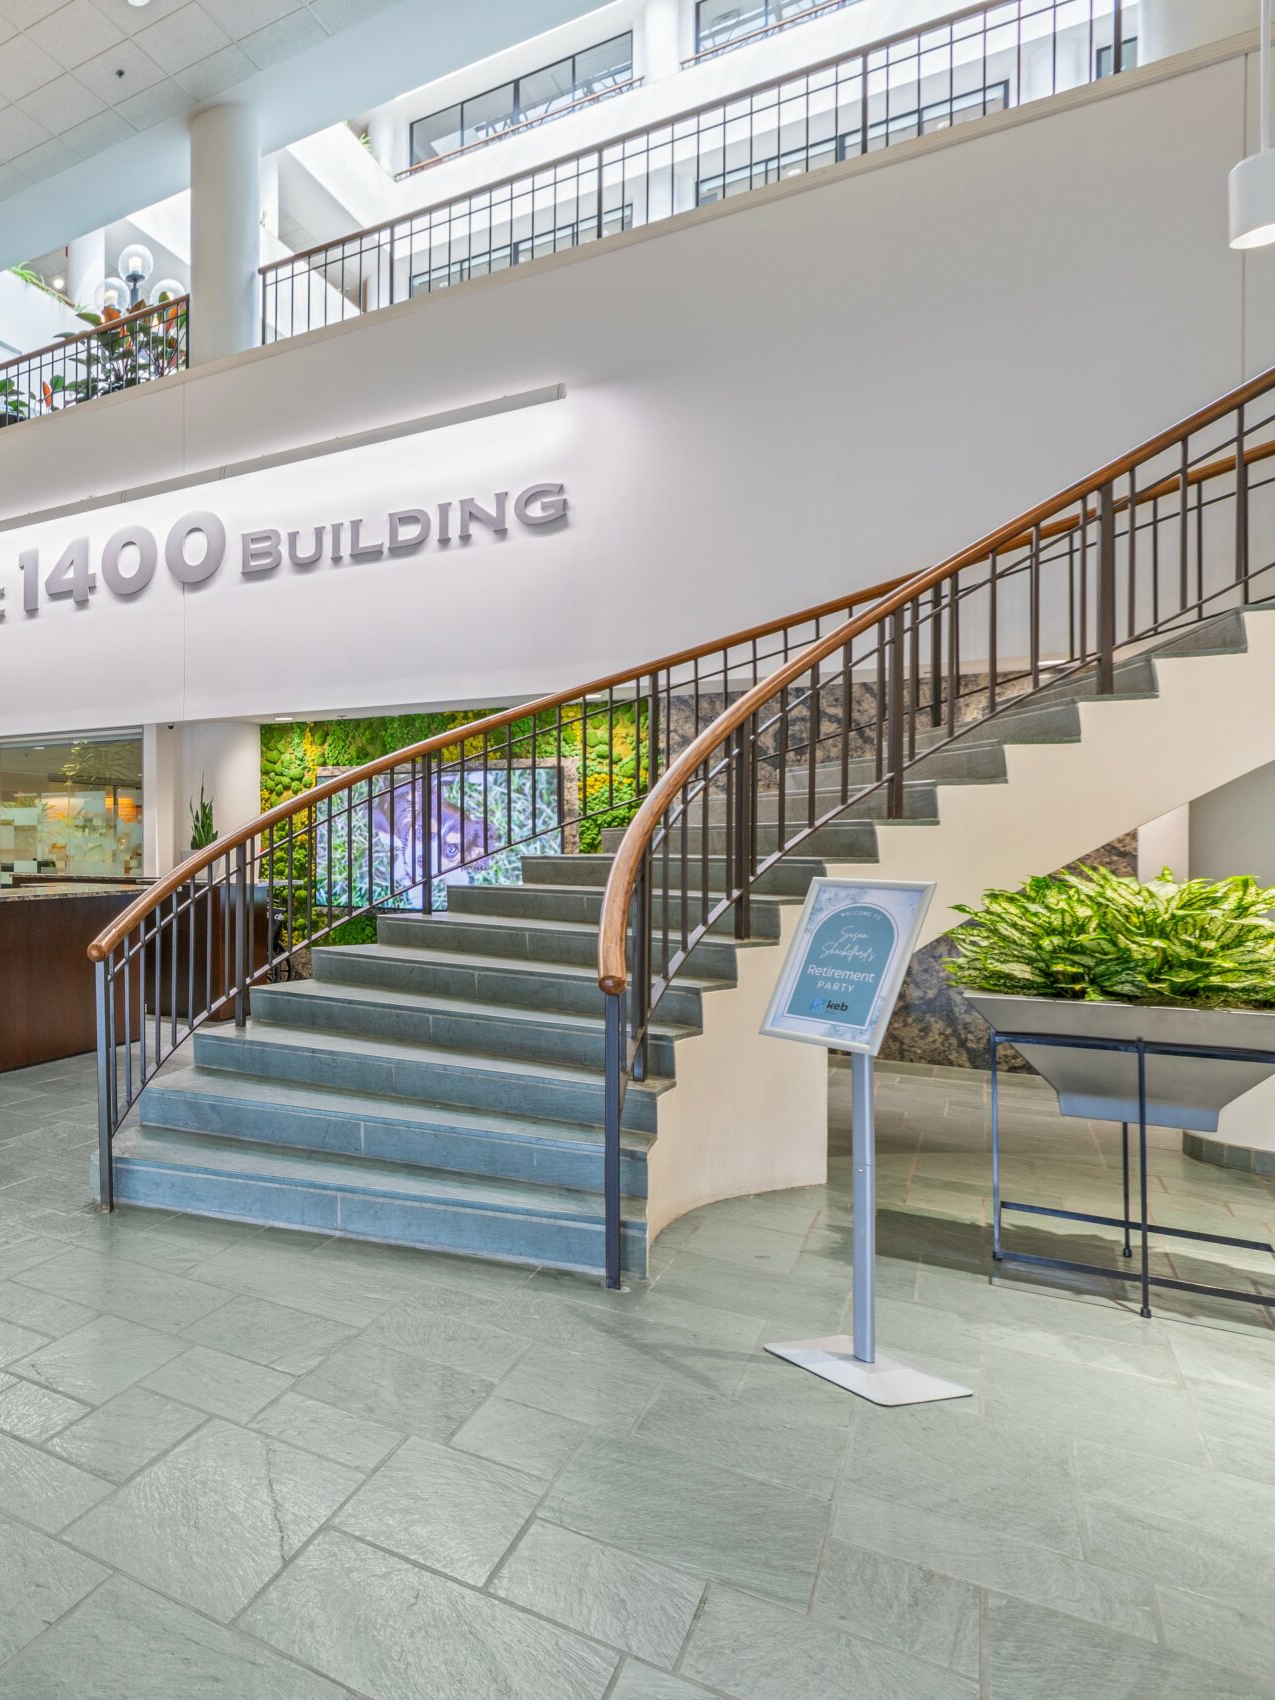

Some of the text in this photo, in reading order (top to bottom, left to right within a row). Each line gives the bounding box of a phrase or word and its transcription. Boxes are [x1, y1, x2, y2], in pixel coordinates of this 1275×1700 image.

[18, 510, 225, 611] 1400
[241, 483, 568, 575] BUILDING
[807, 964, 875, 983] Retirement
[817, 980, 855, 993] PARTY
[826, 1000, 849, 1012] keb
